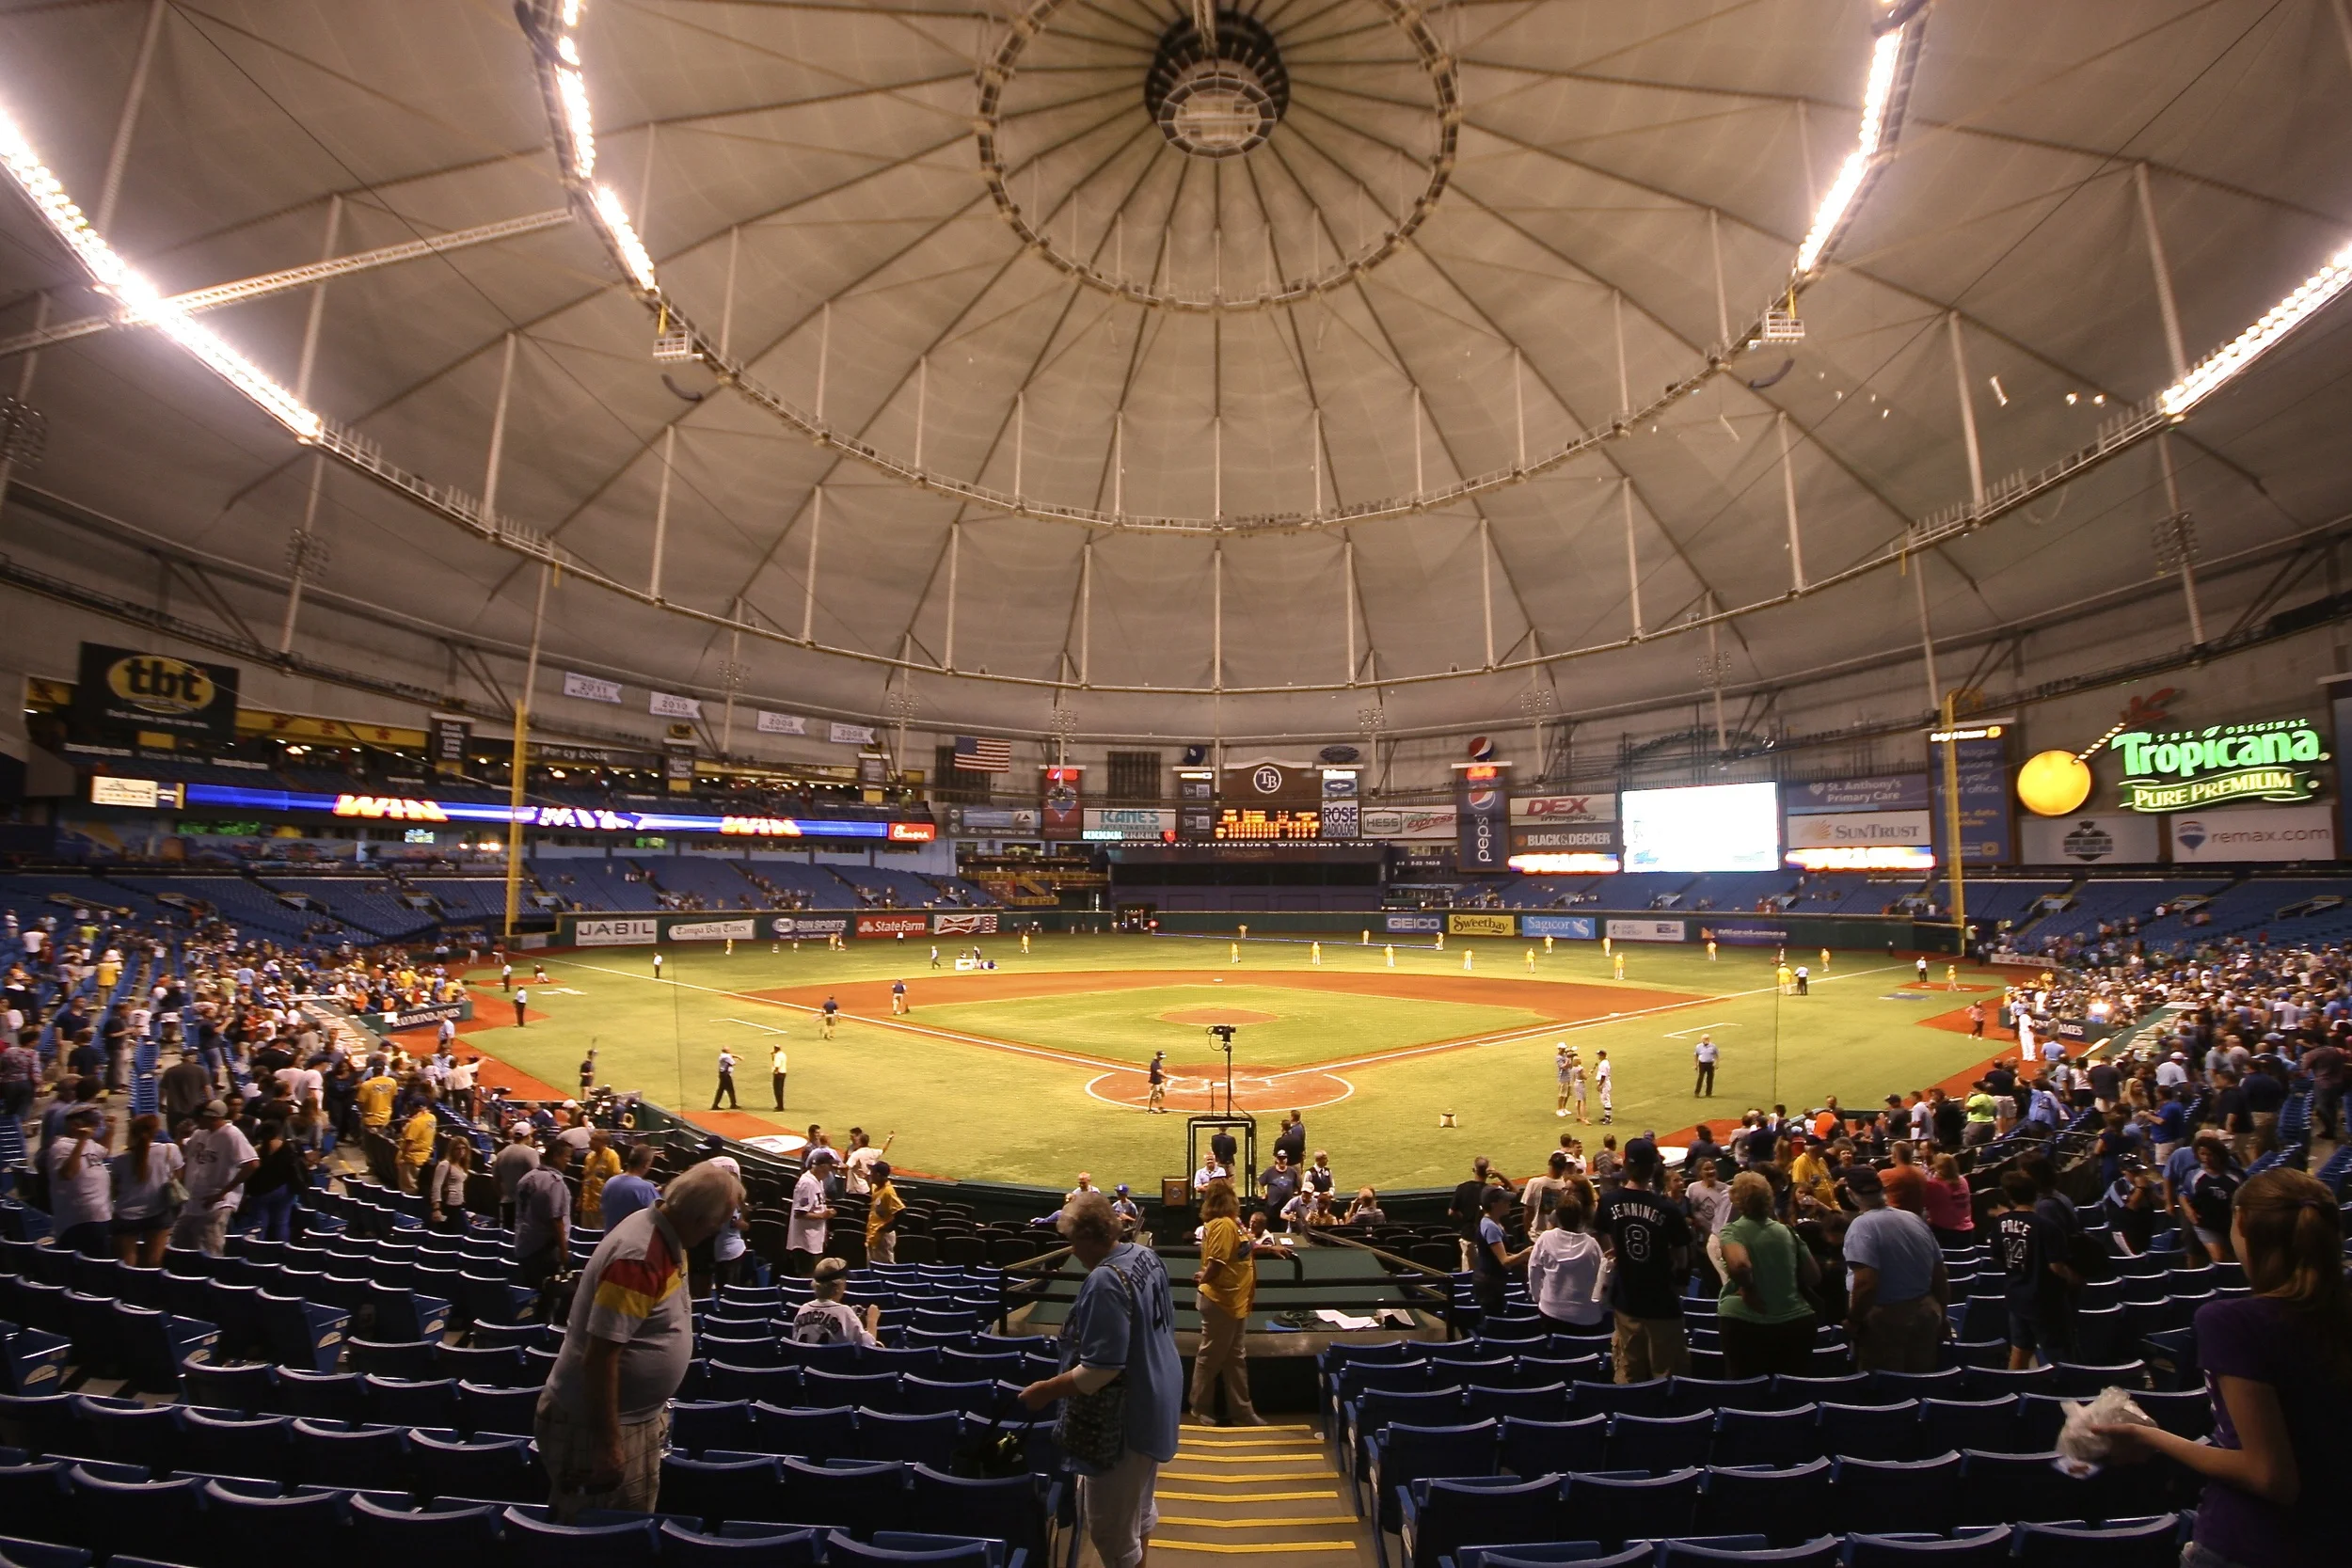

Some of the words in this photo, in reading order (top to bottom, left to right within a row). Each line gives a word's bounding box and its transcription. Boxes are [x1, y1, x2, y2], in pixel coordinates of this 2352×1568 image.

[124, 659, 201, 702] tbt
[580, 682, 608, 693] 2011
[661, 700, 688, 710] 2010
[769, 718, 794, 727] 2008
[2225, 718, 2310, 735] ORIGINAL
[2111, 729, 2320, 777] Tropicana
[1259, 771, 1278, 789] TB
[1828, 783, 1842, 791] St.
[1845, 779, 1901, 791] Anthony's
[2134, 788, 2187, 807] PURE
[2191, 771, 2293, 804] PREMIUM
[1827, 793, 1870, 802] Primary
[1873, 791, 1900, 800] Care
[1526, 797, 1591, 816] DEX
[1324, 807, 1357, 823] ROSE
[1366, 817, 1399, 827] HESS
[1407, 815, 1454, 828] express
[1324, 823, 1357, 836] RADIOLOGY
[2211, 827, 2330, 844] remax.com
[1477, 814, 1492, 863] pepsi
[579, 923, 654, 935] JABIL
[675, 927, 704, 938] Tampa
[705, 925, 722, 934] Bay
[723, 923, 746, 933] Times
[797, 920, 814, 929] SUN
[815, 920, 847, 929] SPORTS
[1388, 918, 1440, 929] GEICO
[1454, 916, 1508, 933] Sweetbay
[1528, 917, 1569, 930] Sagicor
[2058, 1023, 2083, 1036] AMES
[1611, 1203, 1666, 1226] JENNINGS
[1626, 1224, 1650, 1262] 8
